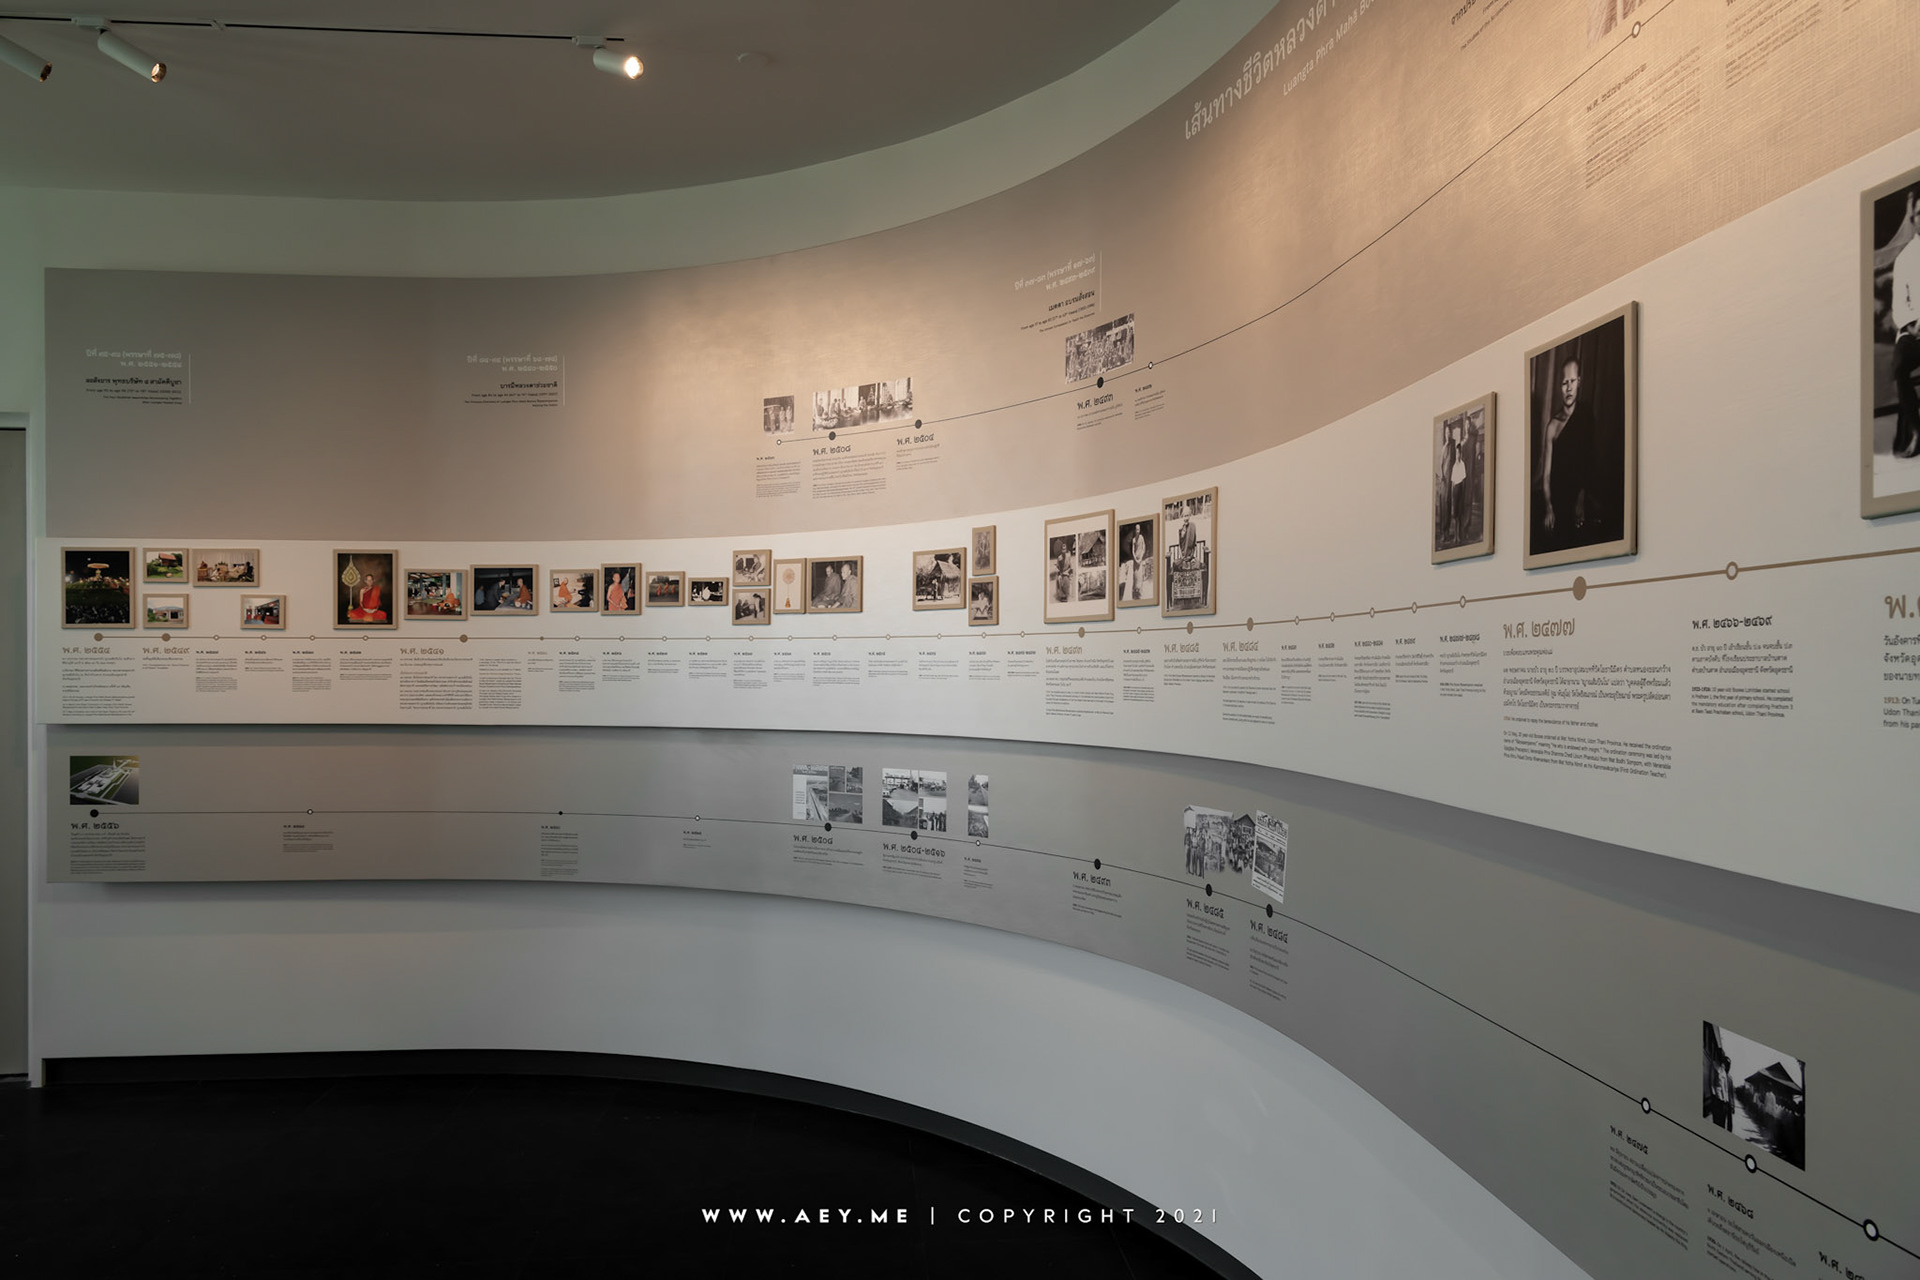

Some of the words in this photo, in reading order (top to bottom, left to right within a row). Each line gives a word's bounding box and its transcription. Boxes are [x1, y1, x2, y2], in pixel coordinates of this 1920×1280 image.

[1284, 60, 1314, 97] Luangta
[1316, 38, 1334, 66] Phra
[1077, 399, 1092, 410] พ.ศ.
[897, 436, 912, 446] พ.ศ.
[813, 447, 828, 456] พ.ศ.
[1884, 594, 1920, 620] พ.
[1503, 622, 1528, 639] พ.ศ.
[1532, 617, 1575, 637] ๒๔๗๗
[1692, 619, 1711, 630] พ.ศ.
[1713, 615, 1773, 628] ๒๔๖๖-๒๔๖๙
[1223, 641, 1238, 652] พ.ศ.
[1883, 708, 1901, 716] Udon
[1883, 720, 1899, 728] from
[71, 822, 90, 830] พ.ศ.
[793, 834, 810, 842] พ.ศ.
[883, 843, 899, 852] พ.ศ.
[1073, 871, 1088, 882] พ.ศ.
[1187, 898, 1202, 912] พ.ศ.
[1250, 919, 1265, 934] พ.ศ.
[1610, 1125, 1625, 1141] พ.ศ.
[1707, 1183, 1726, 1203] พ.ศ.
[1819, 1251, 1842, 1274] พ.ศ.
